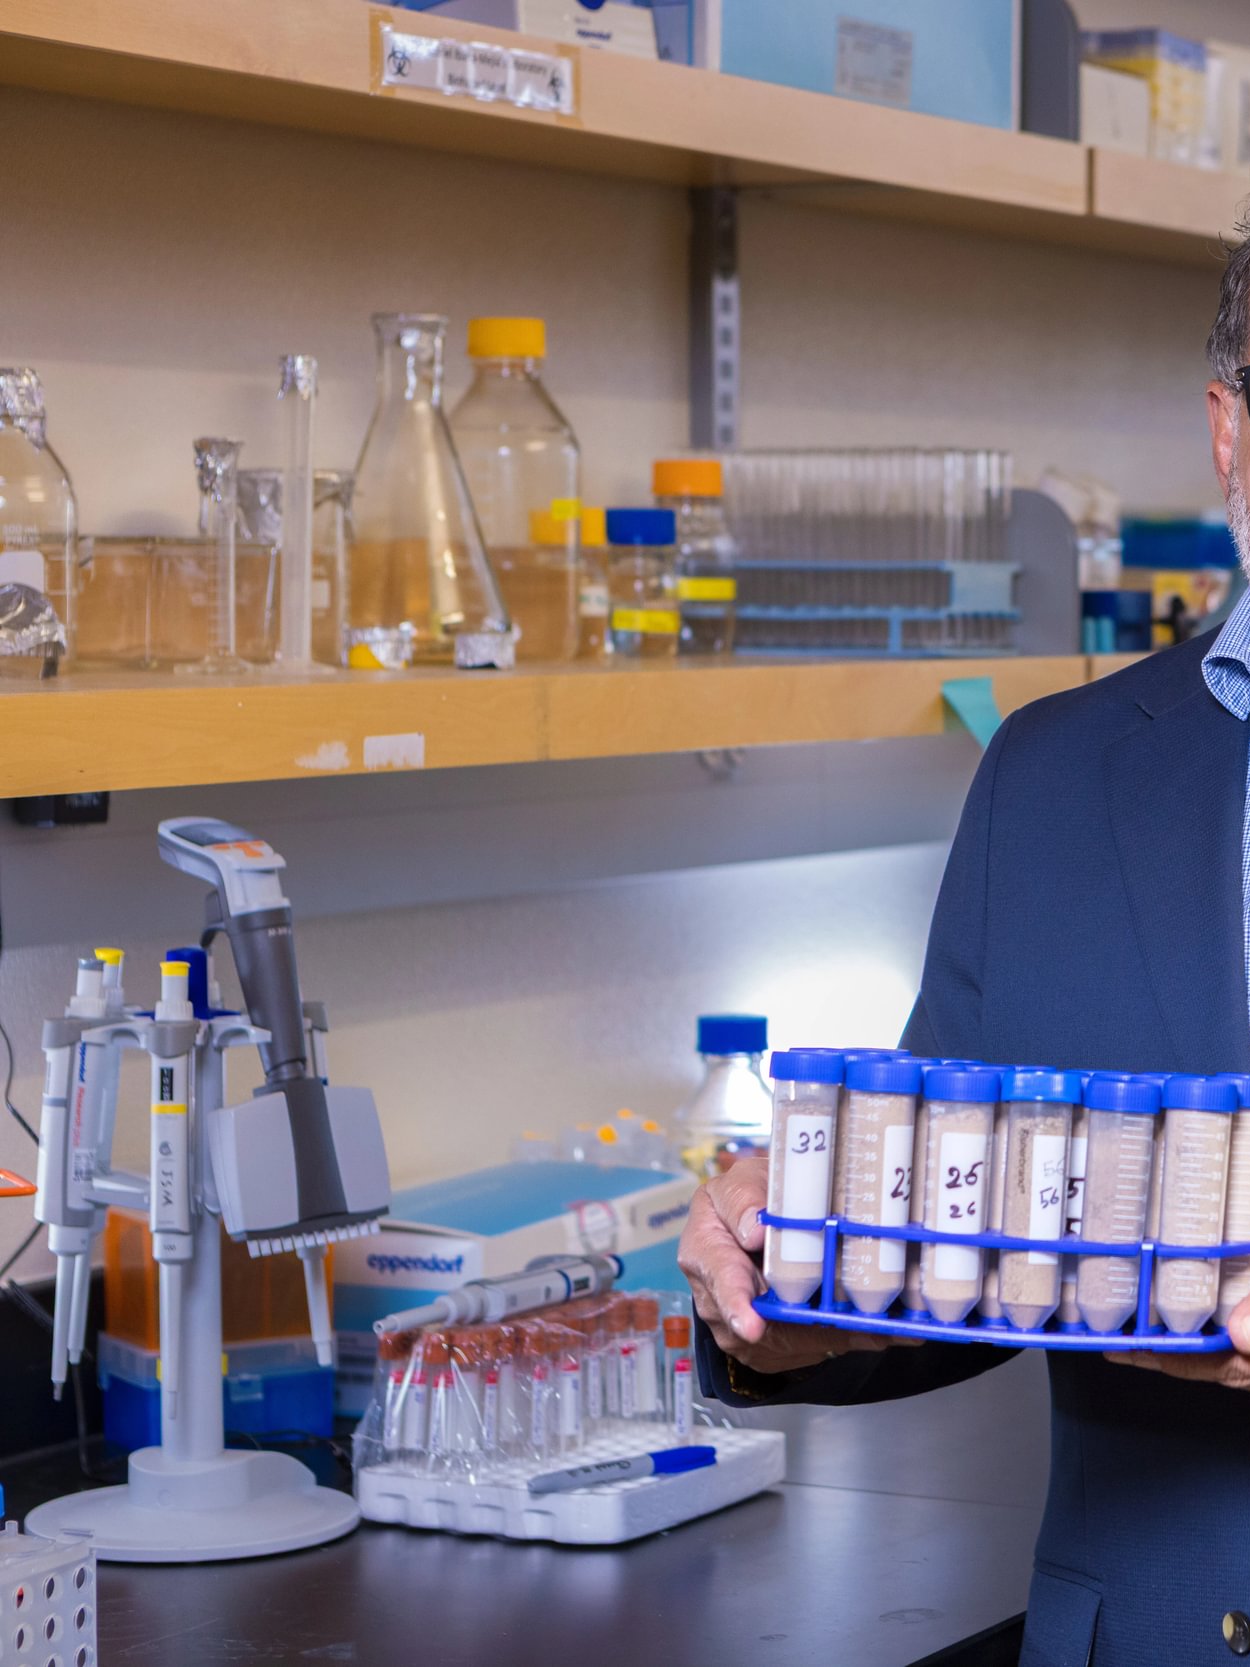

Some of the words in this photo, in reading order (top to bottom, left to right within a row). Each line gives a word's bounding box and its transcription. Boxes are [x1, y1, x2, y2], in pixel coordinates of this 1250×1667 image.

[791, 1129, 826, 1154] 32
[865, 1133, 878, 1143] 40
[945, 1161, 984, 1189] 26
[1040, 1186, 1060, 1209] 56
[949, 1201, 976, 1219] 26
[366, 1253, 464, 1275] eppendorf
[861, 1255, 872, 1264] 10
